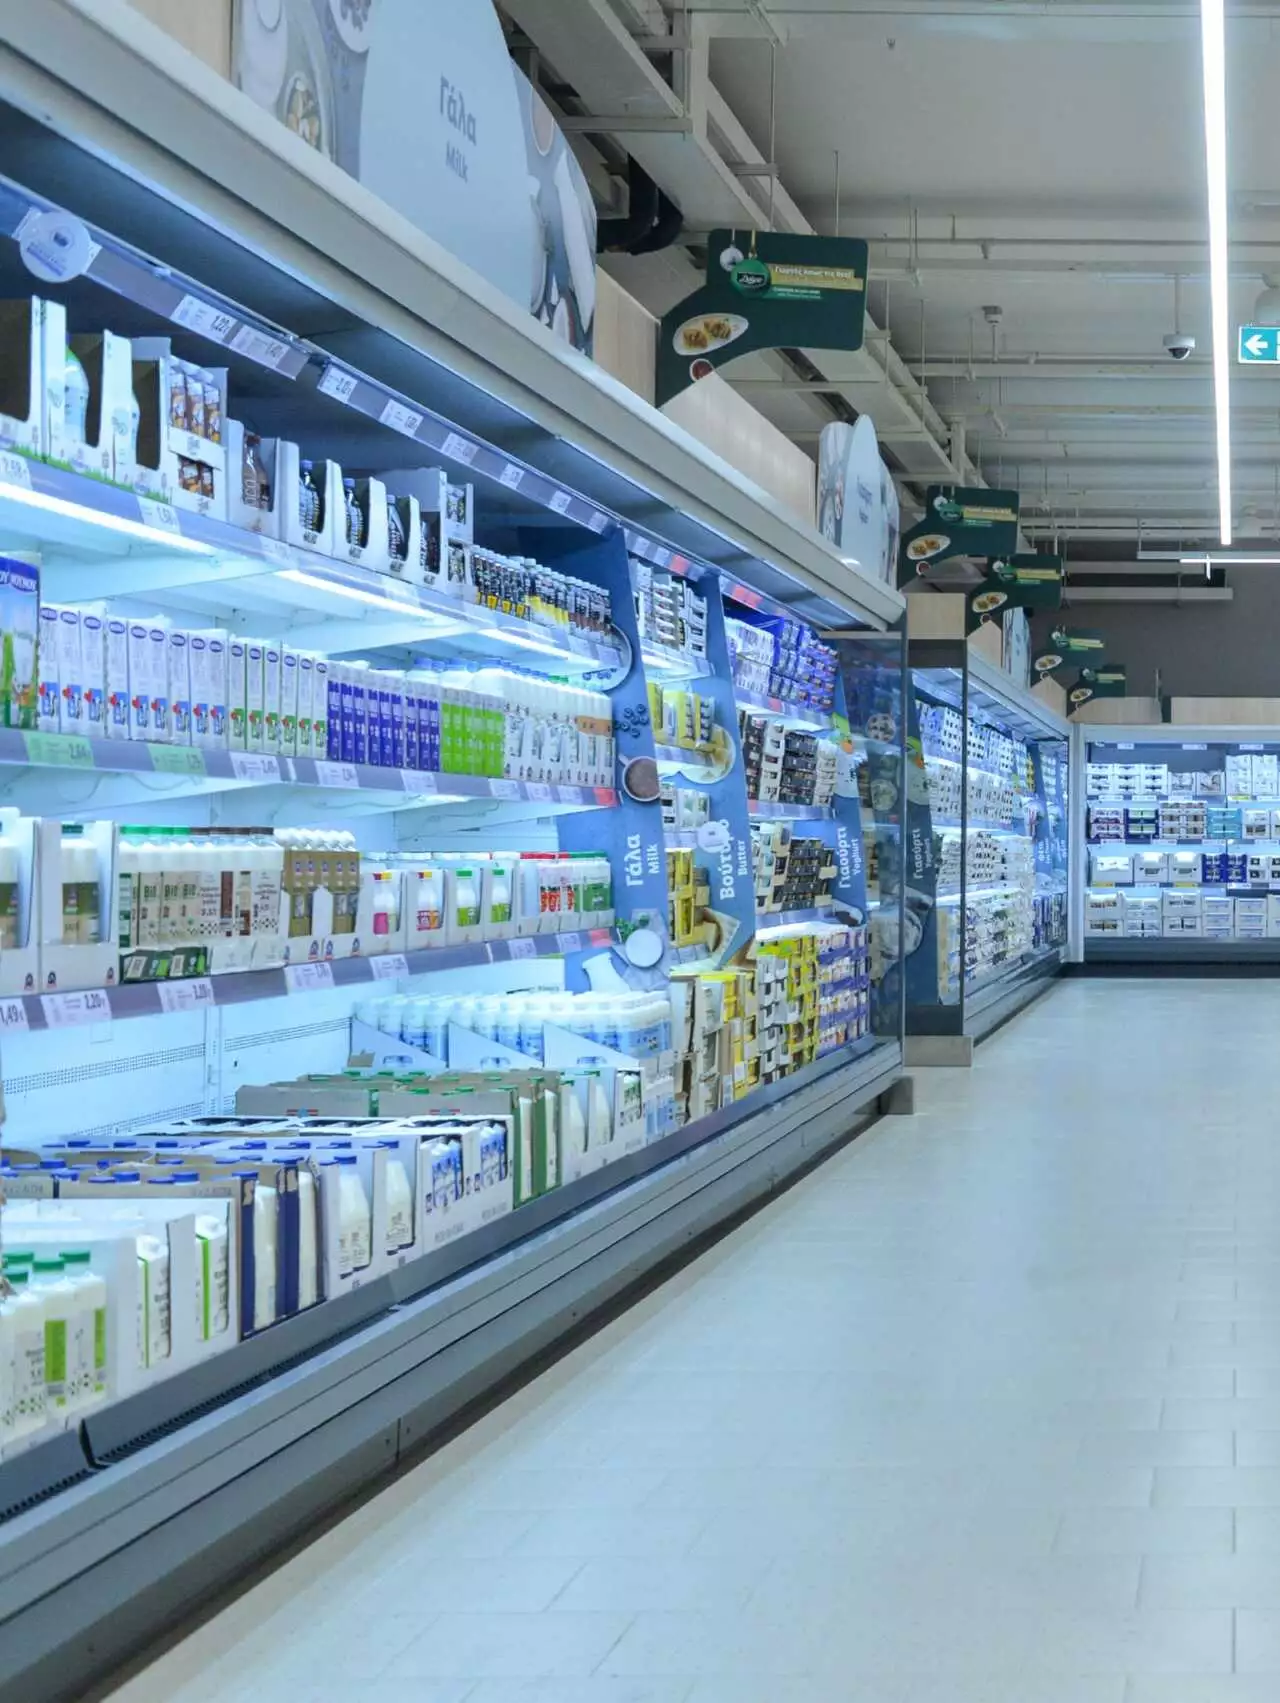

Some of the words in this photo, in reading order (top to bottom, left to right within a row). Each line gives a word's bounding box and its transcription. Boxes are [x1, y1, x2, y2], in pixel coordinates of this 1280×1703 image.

[440, 74, 477, 147] Γάλα
[445, 140, 468, 184] Milk
[624, 832, 644, 887] Γάλα
[647, 843, 661, 875] Milk
[737, 839, 749, 876] Butter
[836, 826, 852, 889] Γιαούρτι
[912, 827, 924, 880] Γιαούρτι
